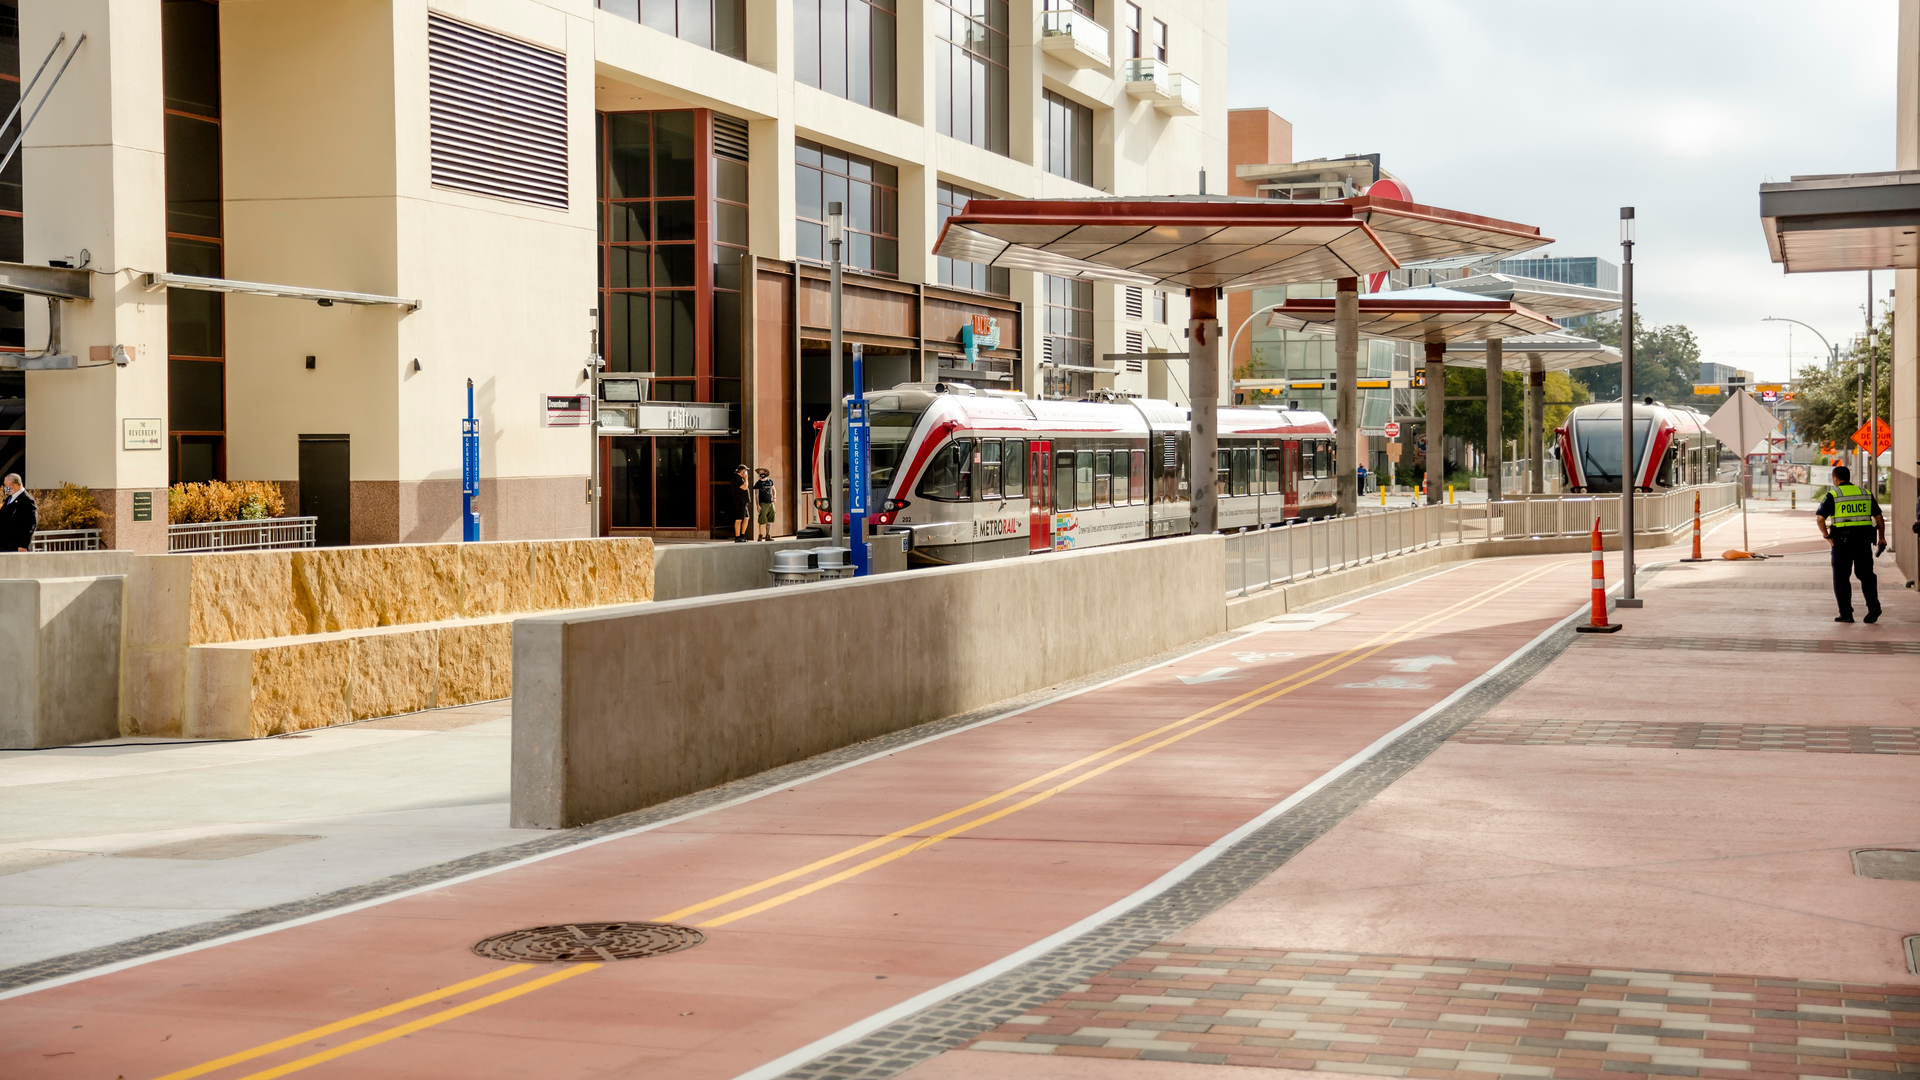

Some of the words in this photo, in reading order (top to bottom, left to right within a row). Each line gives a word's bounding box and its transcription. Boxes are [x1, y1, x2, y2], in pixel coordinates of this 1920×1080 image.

[973, 314, 991, 335] TACOS
[548, 399, 569, 408] Downtown
[670, 408, 702, 429] Hilton
[1841, 504, 1866, 513] POLICE
[980, 518, 1016, 537] METRORAIL
